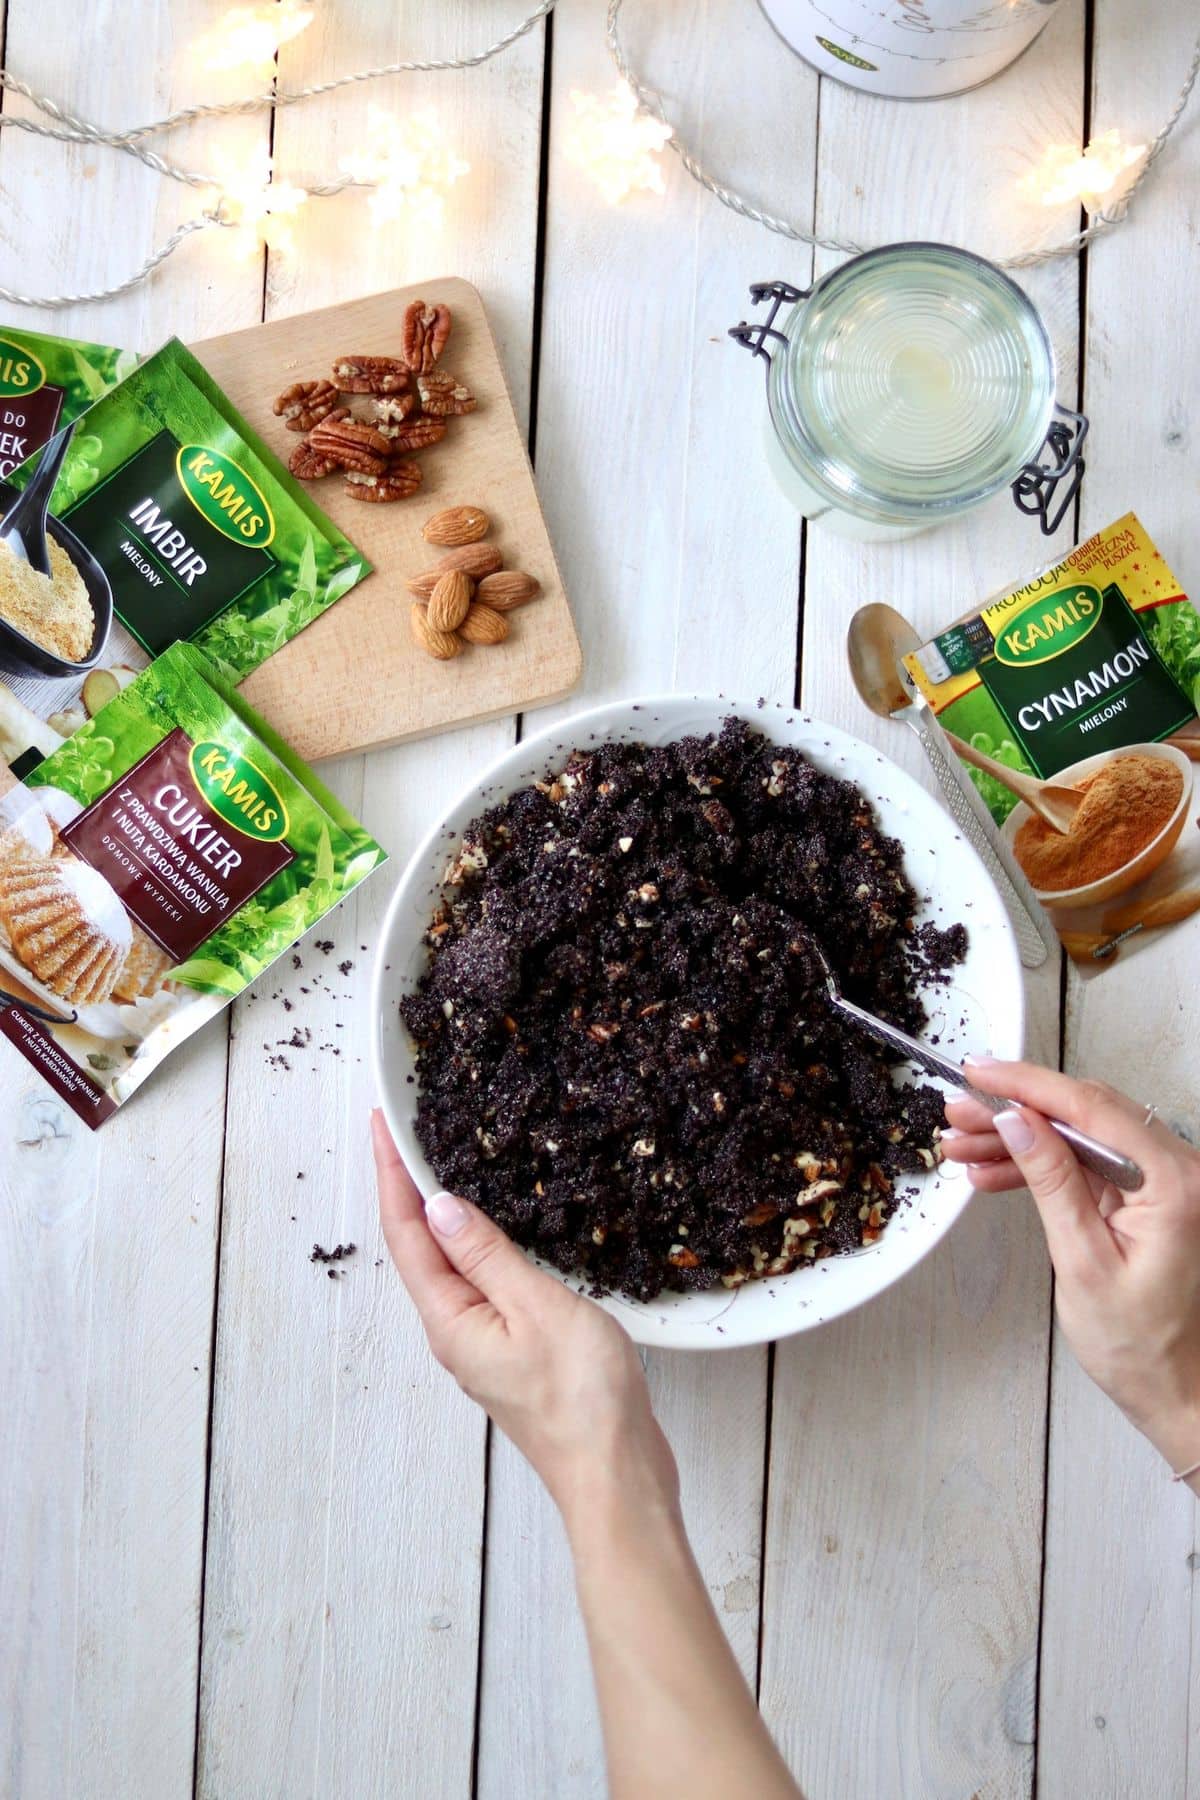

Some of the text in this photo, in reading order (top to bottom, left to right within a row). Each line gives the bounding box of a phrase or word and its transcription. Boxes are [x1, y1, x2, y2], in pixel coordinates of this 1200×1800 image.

[4, 411, 26, 428] DO
[188, 452, 264, 537] KAMIS
[120, 541, 164, 587] MIELONY
[129, 498, 207, 586] IMBIR
[1068, 532, 1102, 567] ODBIERZ
[1004, 592, 1094, 656] KAMIS
[1018, 638, 1149, 731] CYNAMON
[1079, 698, 1128, 734] MIELONY
[201, 748, 278, 831] KAMIS
[112, 808, 212, 915] I NUTĄ KARDAMONU
[119, 789, 230, 911] Z PRAWDZIWĄ WANILIĄ
[154, 784, 242, 879] CUKIER
[102, 835, 183, 922] DOMOWE WYPIEKI
[11, 1010, 34, 1034] CUKIER
[32, 1032, 40, 1040] Z
[40, 1053, 78, 1092] KARDAMONU
